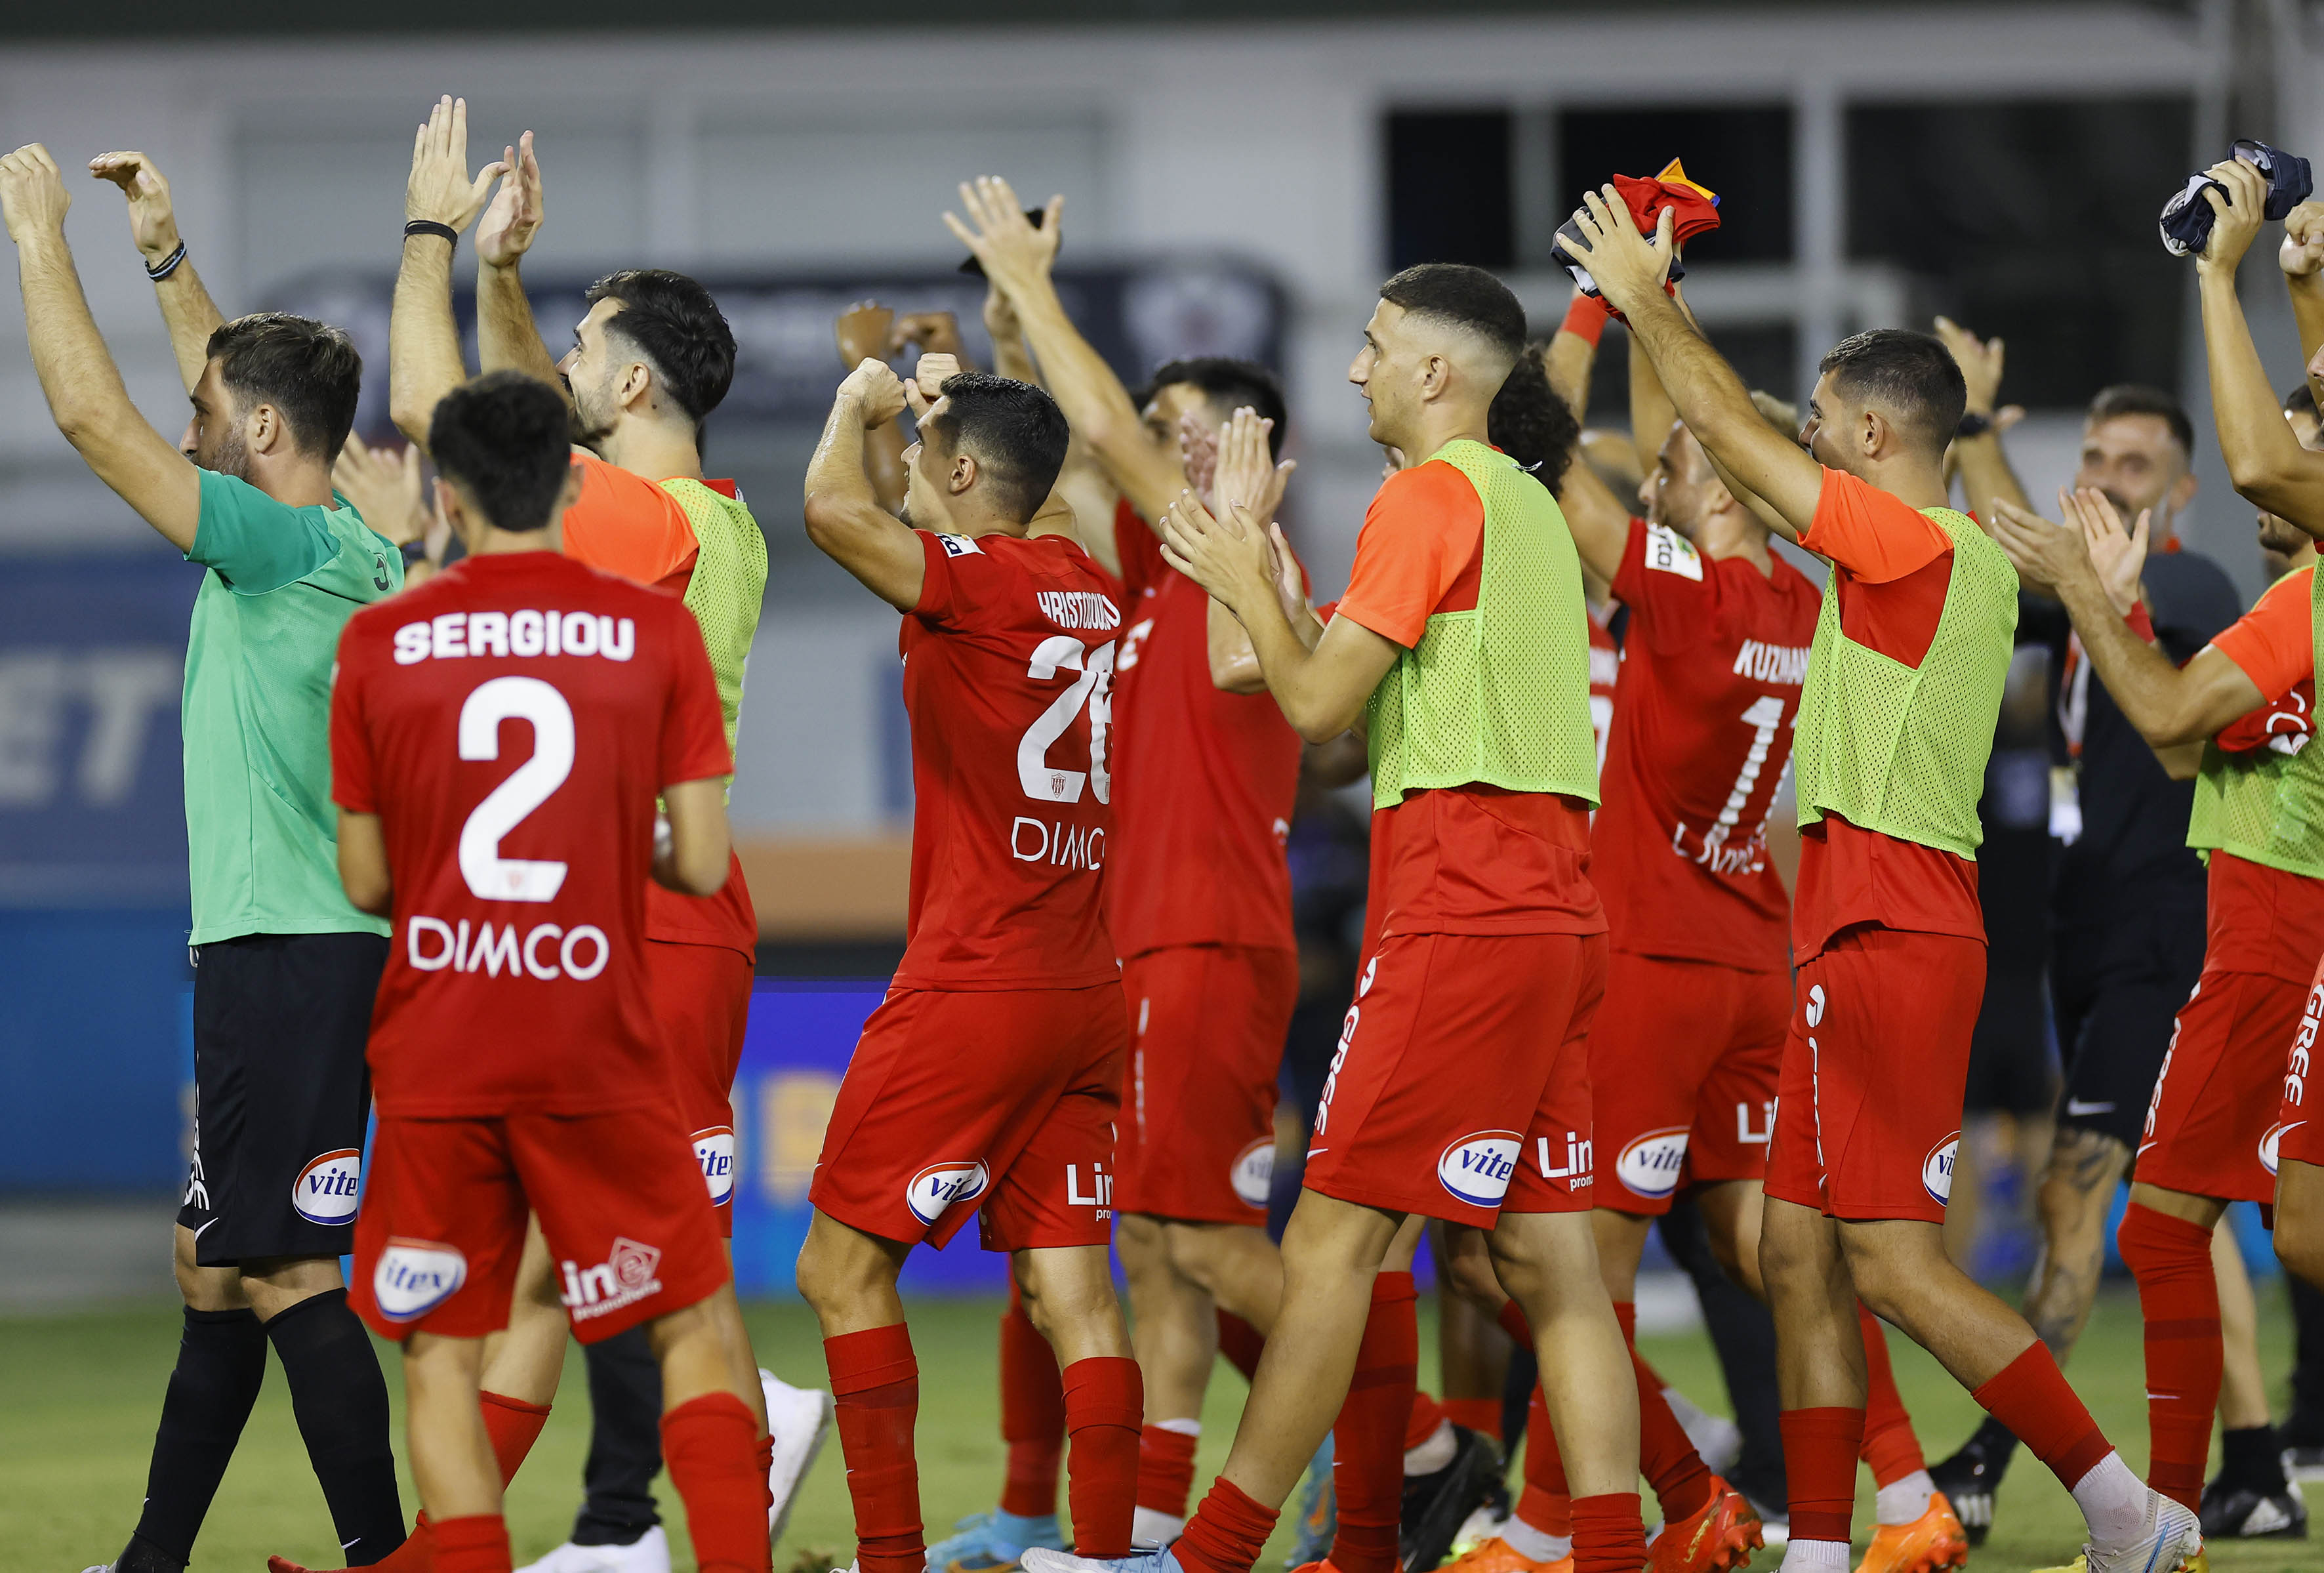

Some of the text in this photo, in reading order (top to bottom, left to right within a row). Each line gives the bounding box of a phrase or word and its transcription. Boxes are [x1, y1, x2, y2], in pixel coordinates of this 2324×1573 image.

[394, 609, 635, 665] SERGIOU
[459, 675, 575, 903] 2
[1011, 816, 1106, 871] DIMC
[407, 916, 610, 981] DIMCO
[2285, 984, 2324, 1107] GREE
[309, 1168, 359, 1196] vite
[1462, 1147, 1513, 1182] vite
[1938, 1149, 1955, 1177] vi
[1096, 1209, 1112, 1222] pro
